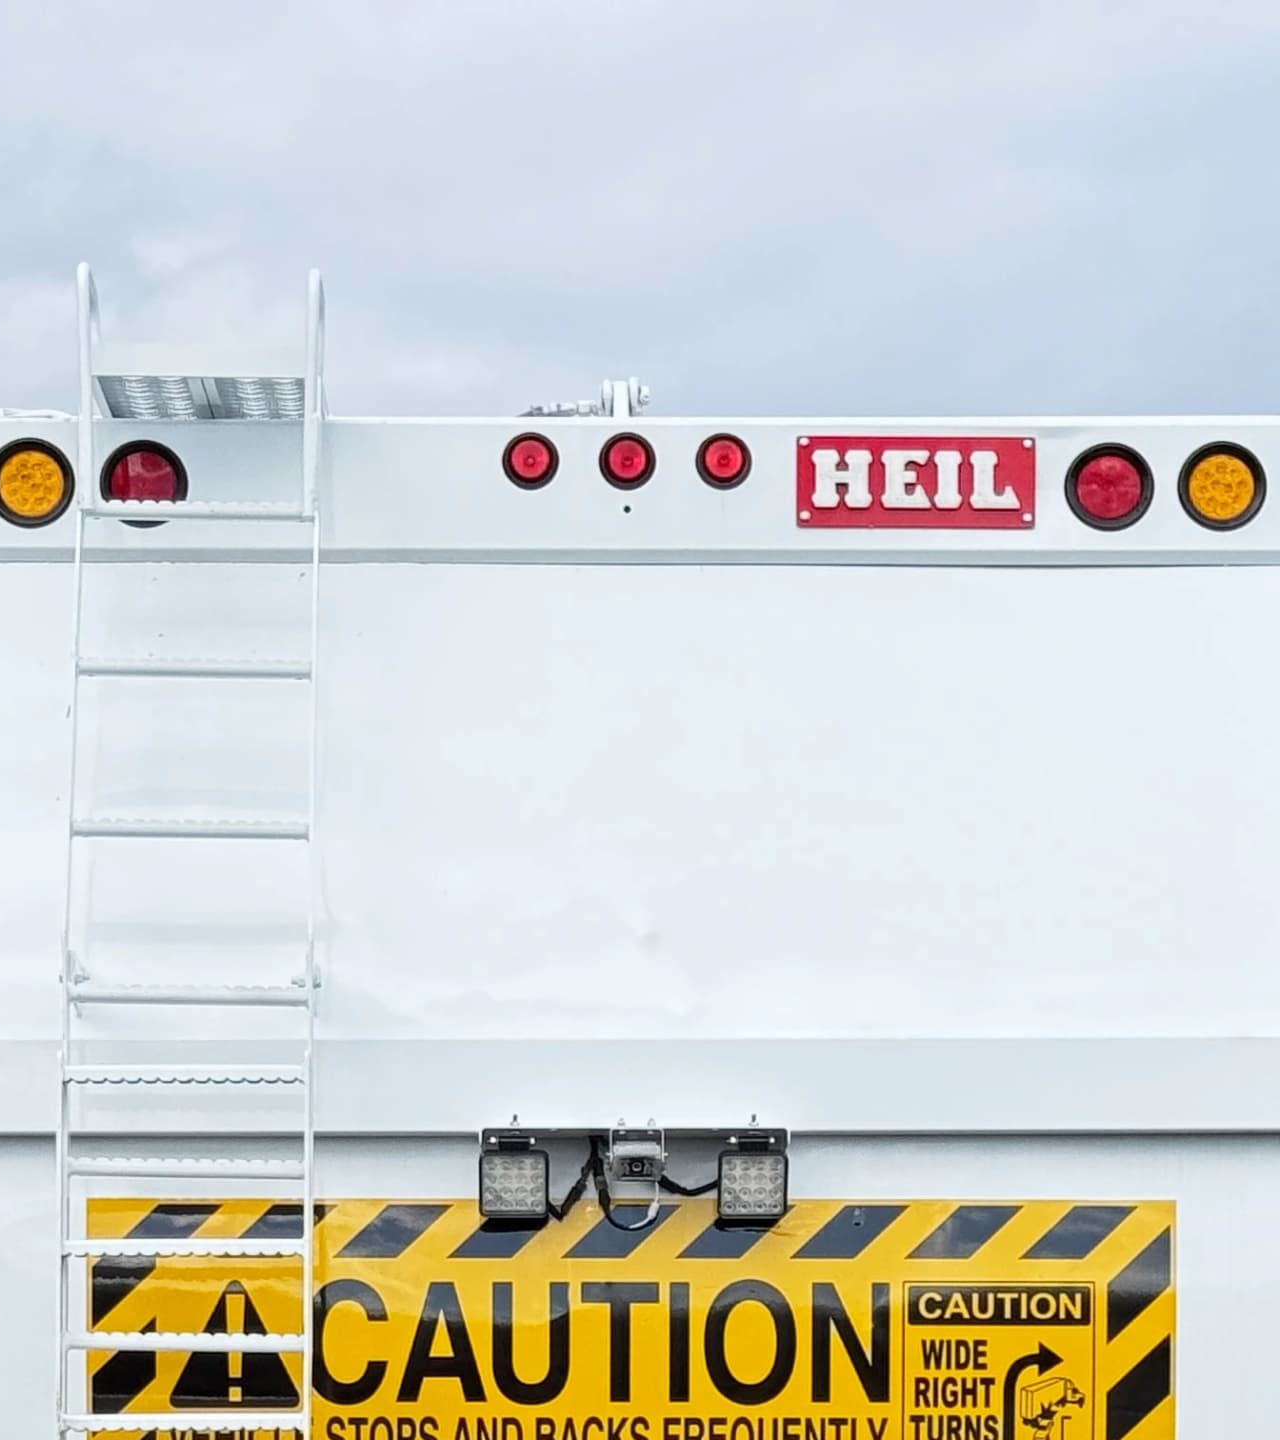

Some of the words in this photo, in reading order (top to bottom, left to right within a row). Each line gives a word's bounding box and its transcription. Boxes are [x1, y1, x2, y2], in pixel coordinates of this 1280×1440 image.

[811, 449, 1020, 509] HEIL
[918, 1292, 1082, 1320] CAUTION
[312, 1279, 890, 1405] CAUTION
[921, 1339, 988, 1370] WIDE
[914, 1377, 995, 1408] RIGHT
